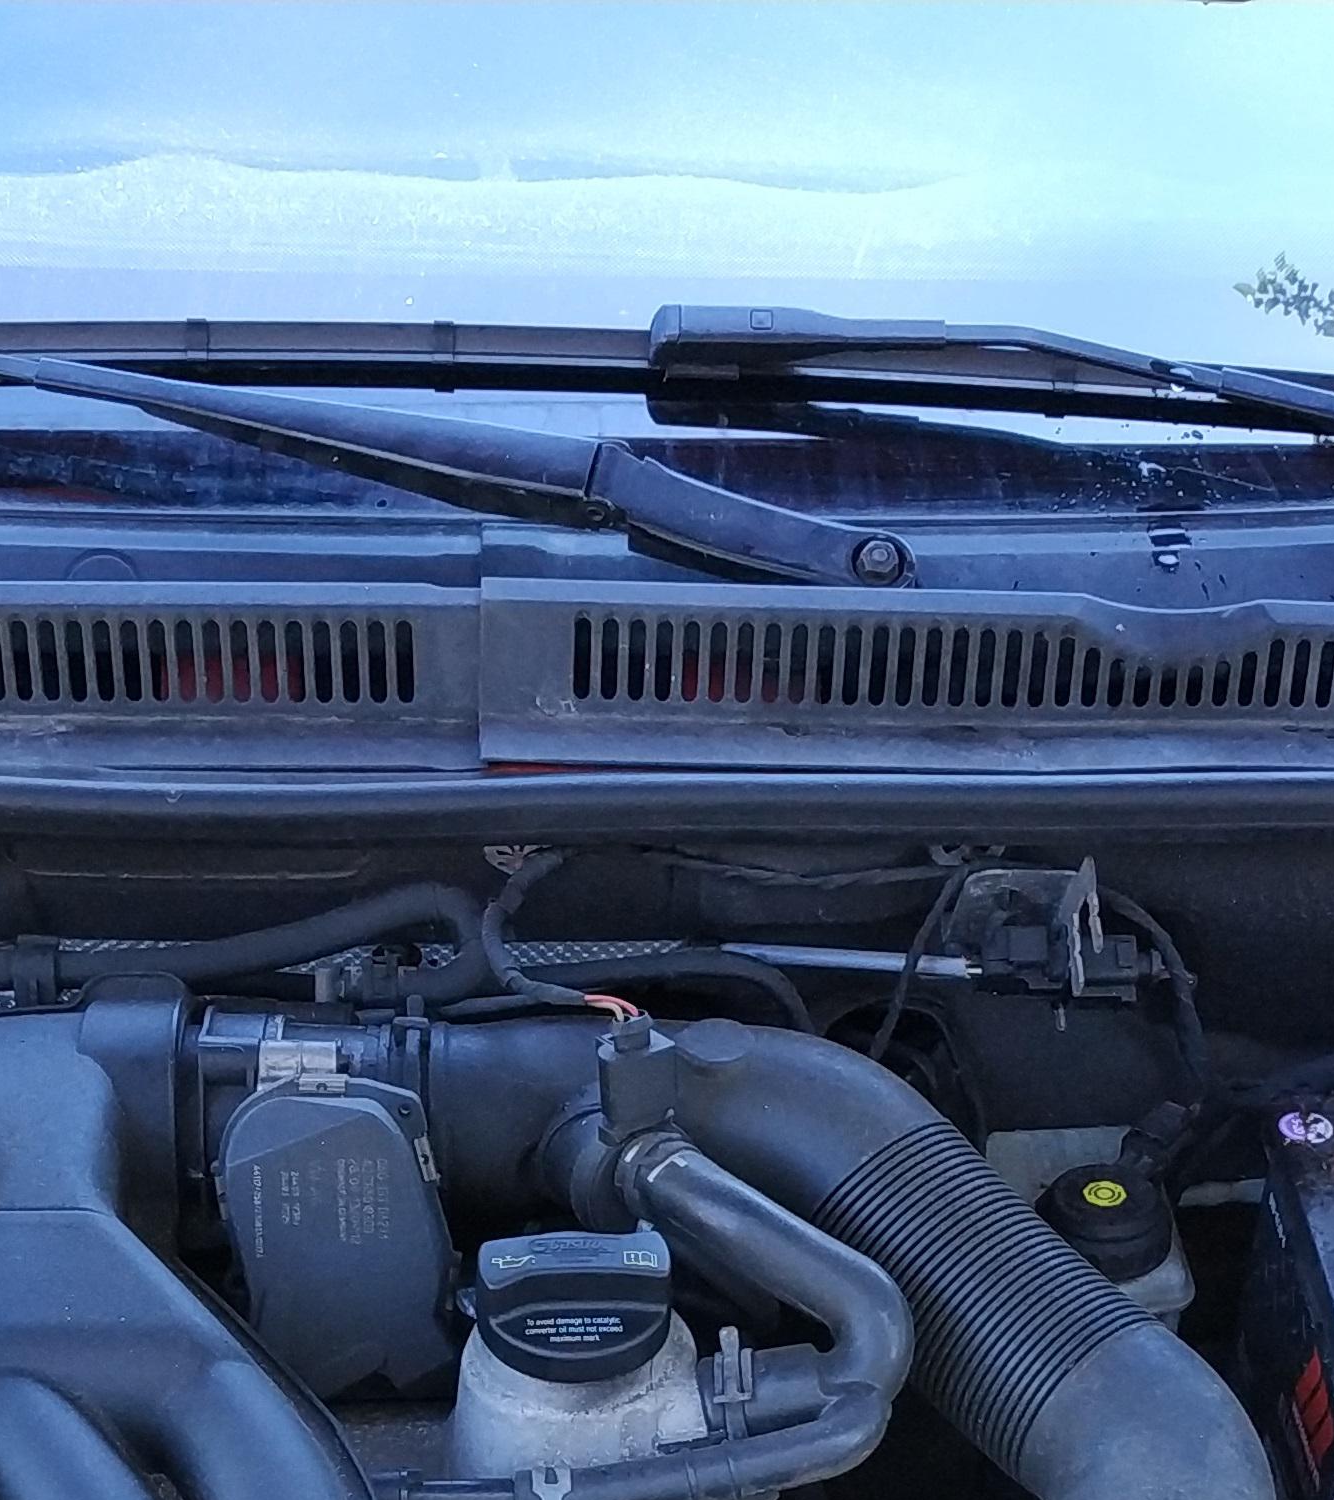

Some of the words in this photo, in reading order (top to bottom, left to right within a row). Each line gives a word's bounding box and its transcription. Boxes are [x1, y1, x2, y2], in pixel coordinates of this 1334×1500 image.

[526, 1318, 535, 1326] To
[536, 1318, 555, 1326] avoid
[556, 1318, 583, 1326] damage
[593, 1316, 621, 1325] catalytic
[525, 1327, 557, 1335] converter
[598, 1325, 623, 1333] exceed
[582, 1334, 601, 1342] mark
